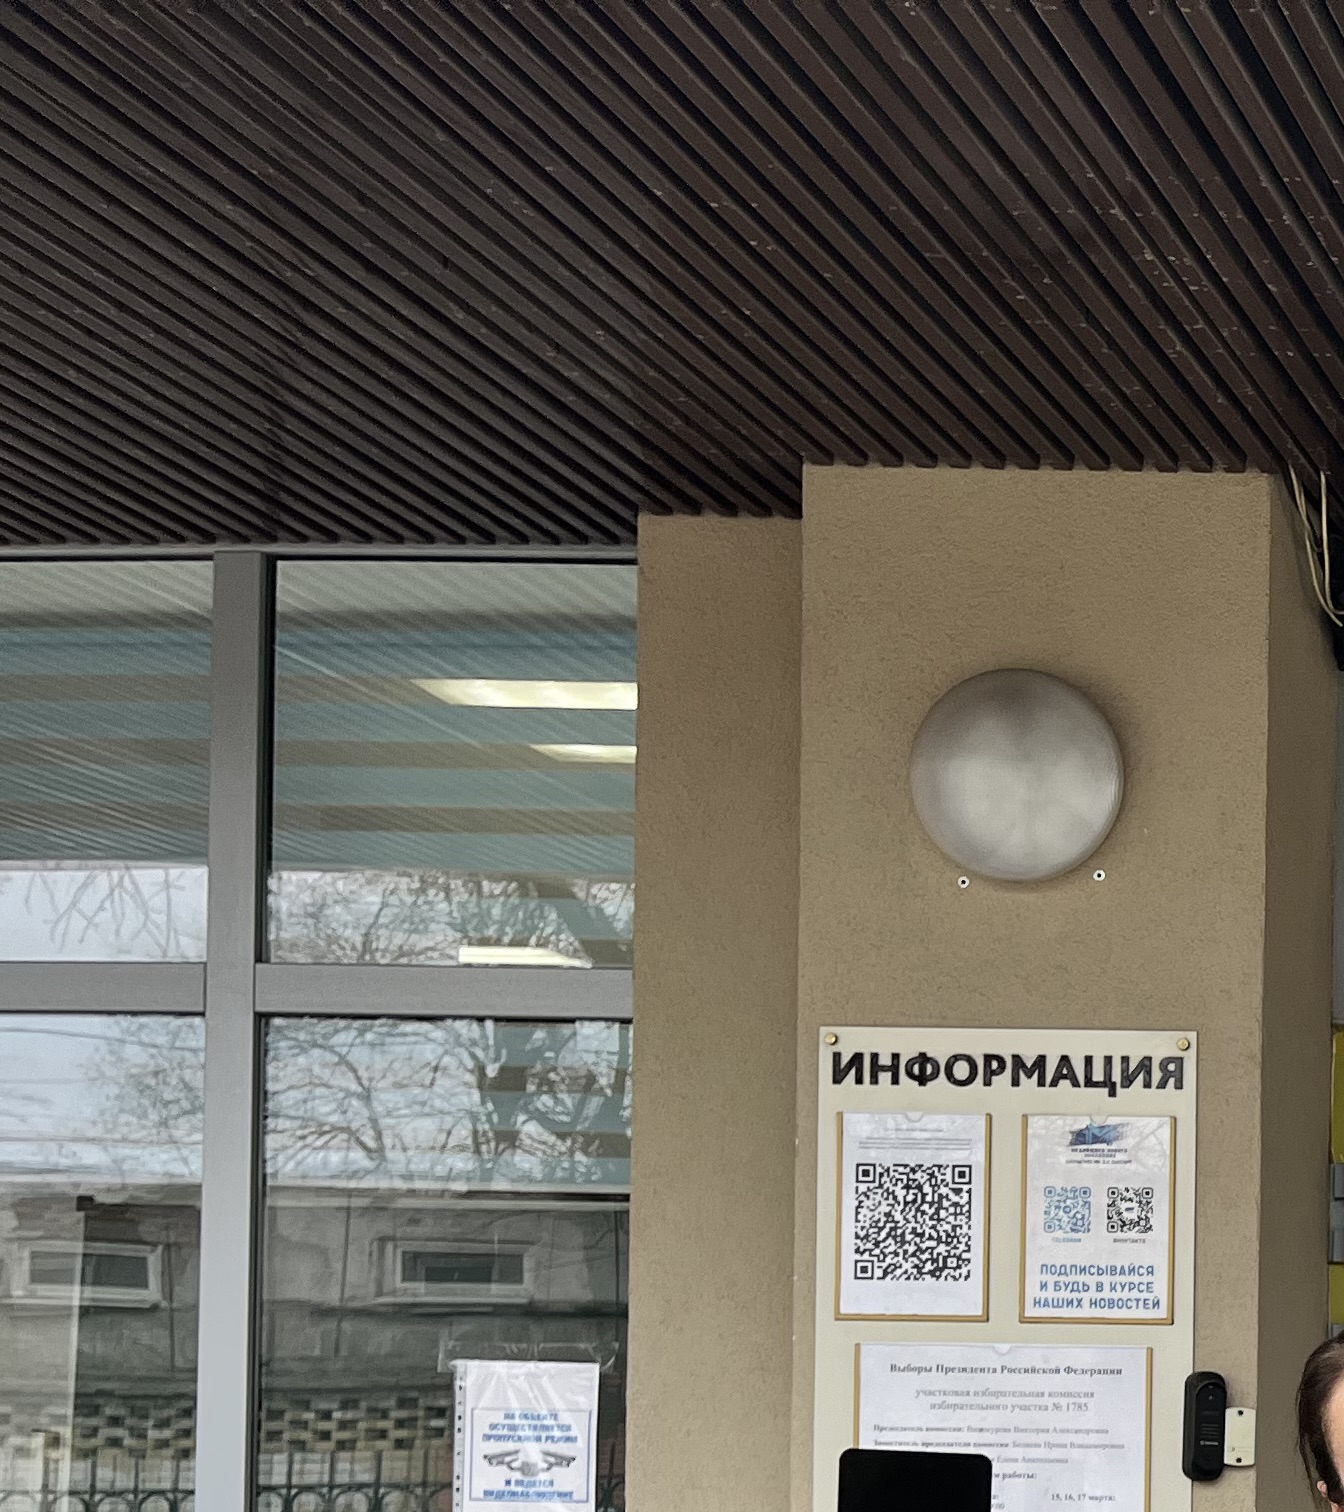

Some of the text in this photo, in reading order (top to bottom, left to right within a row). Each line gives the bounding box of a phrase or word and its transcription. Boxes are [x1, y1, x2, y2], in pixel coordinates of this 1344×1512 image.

[832, 1051, 1185, 1098] ИНФОРМАЦИЯ
[1040, 1262, 1155, 1277] ПОДПИСЫВАЙСЯ
[1039, 1281, 1154, 1294] И БУДЬ В КУРСЕ
[1033, 1296, 1160, 1310] НАШИХ НОВОСТЕЙ
[890, 1364, 932, 1375] Выборы
[936, 1364, 997, 1376] Президента
[1000, 1365, 1060, 1375] Российской
[1066, 1402, 1089, 1412] 1785
